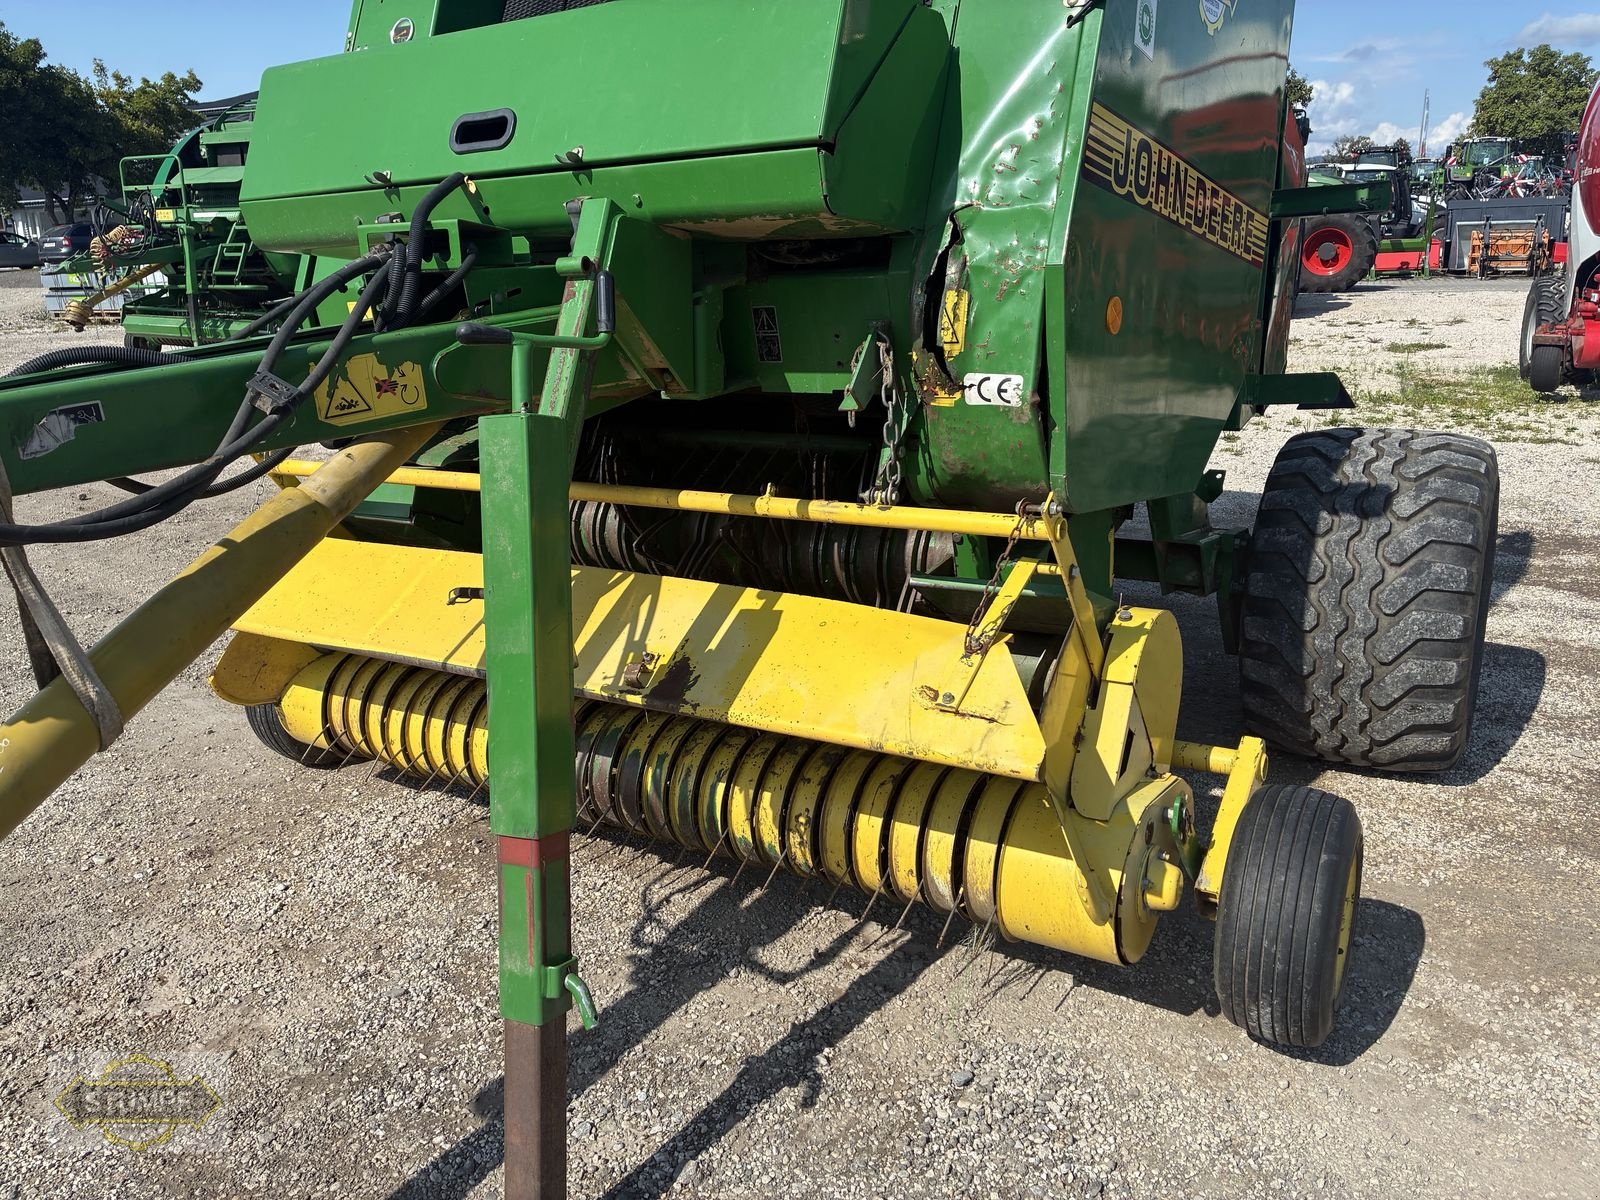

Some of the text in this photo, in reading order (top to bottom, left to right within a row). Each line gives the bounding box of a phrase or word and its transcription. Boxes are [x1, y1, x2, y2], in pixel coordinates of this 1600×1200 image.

[1112, 128, 1256, 258] JOHN DEERE
[977, 376, 1012, 404] CE
